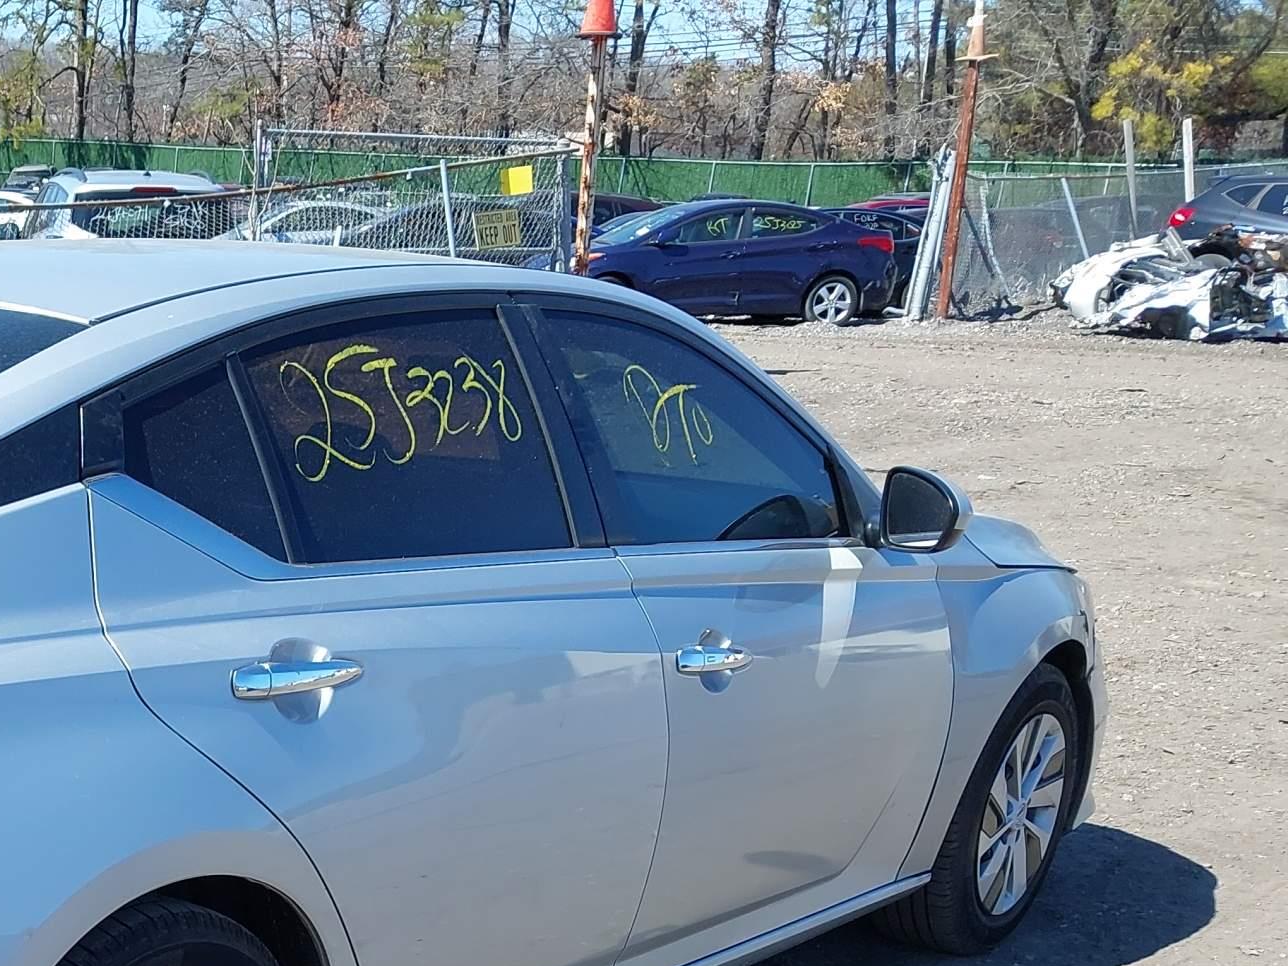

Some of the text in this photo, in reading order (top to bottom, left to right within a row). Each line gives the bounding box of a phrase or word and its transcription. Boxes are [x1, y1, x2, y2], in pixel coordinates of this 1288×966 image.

[478, 223, 518, 246] KEEP OUT
[279, 344, 523, 482] 25J3238
